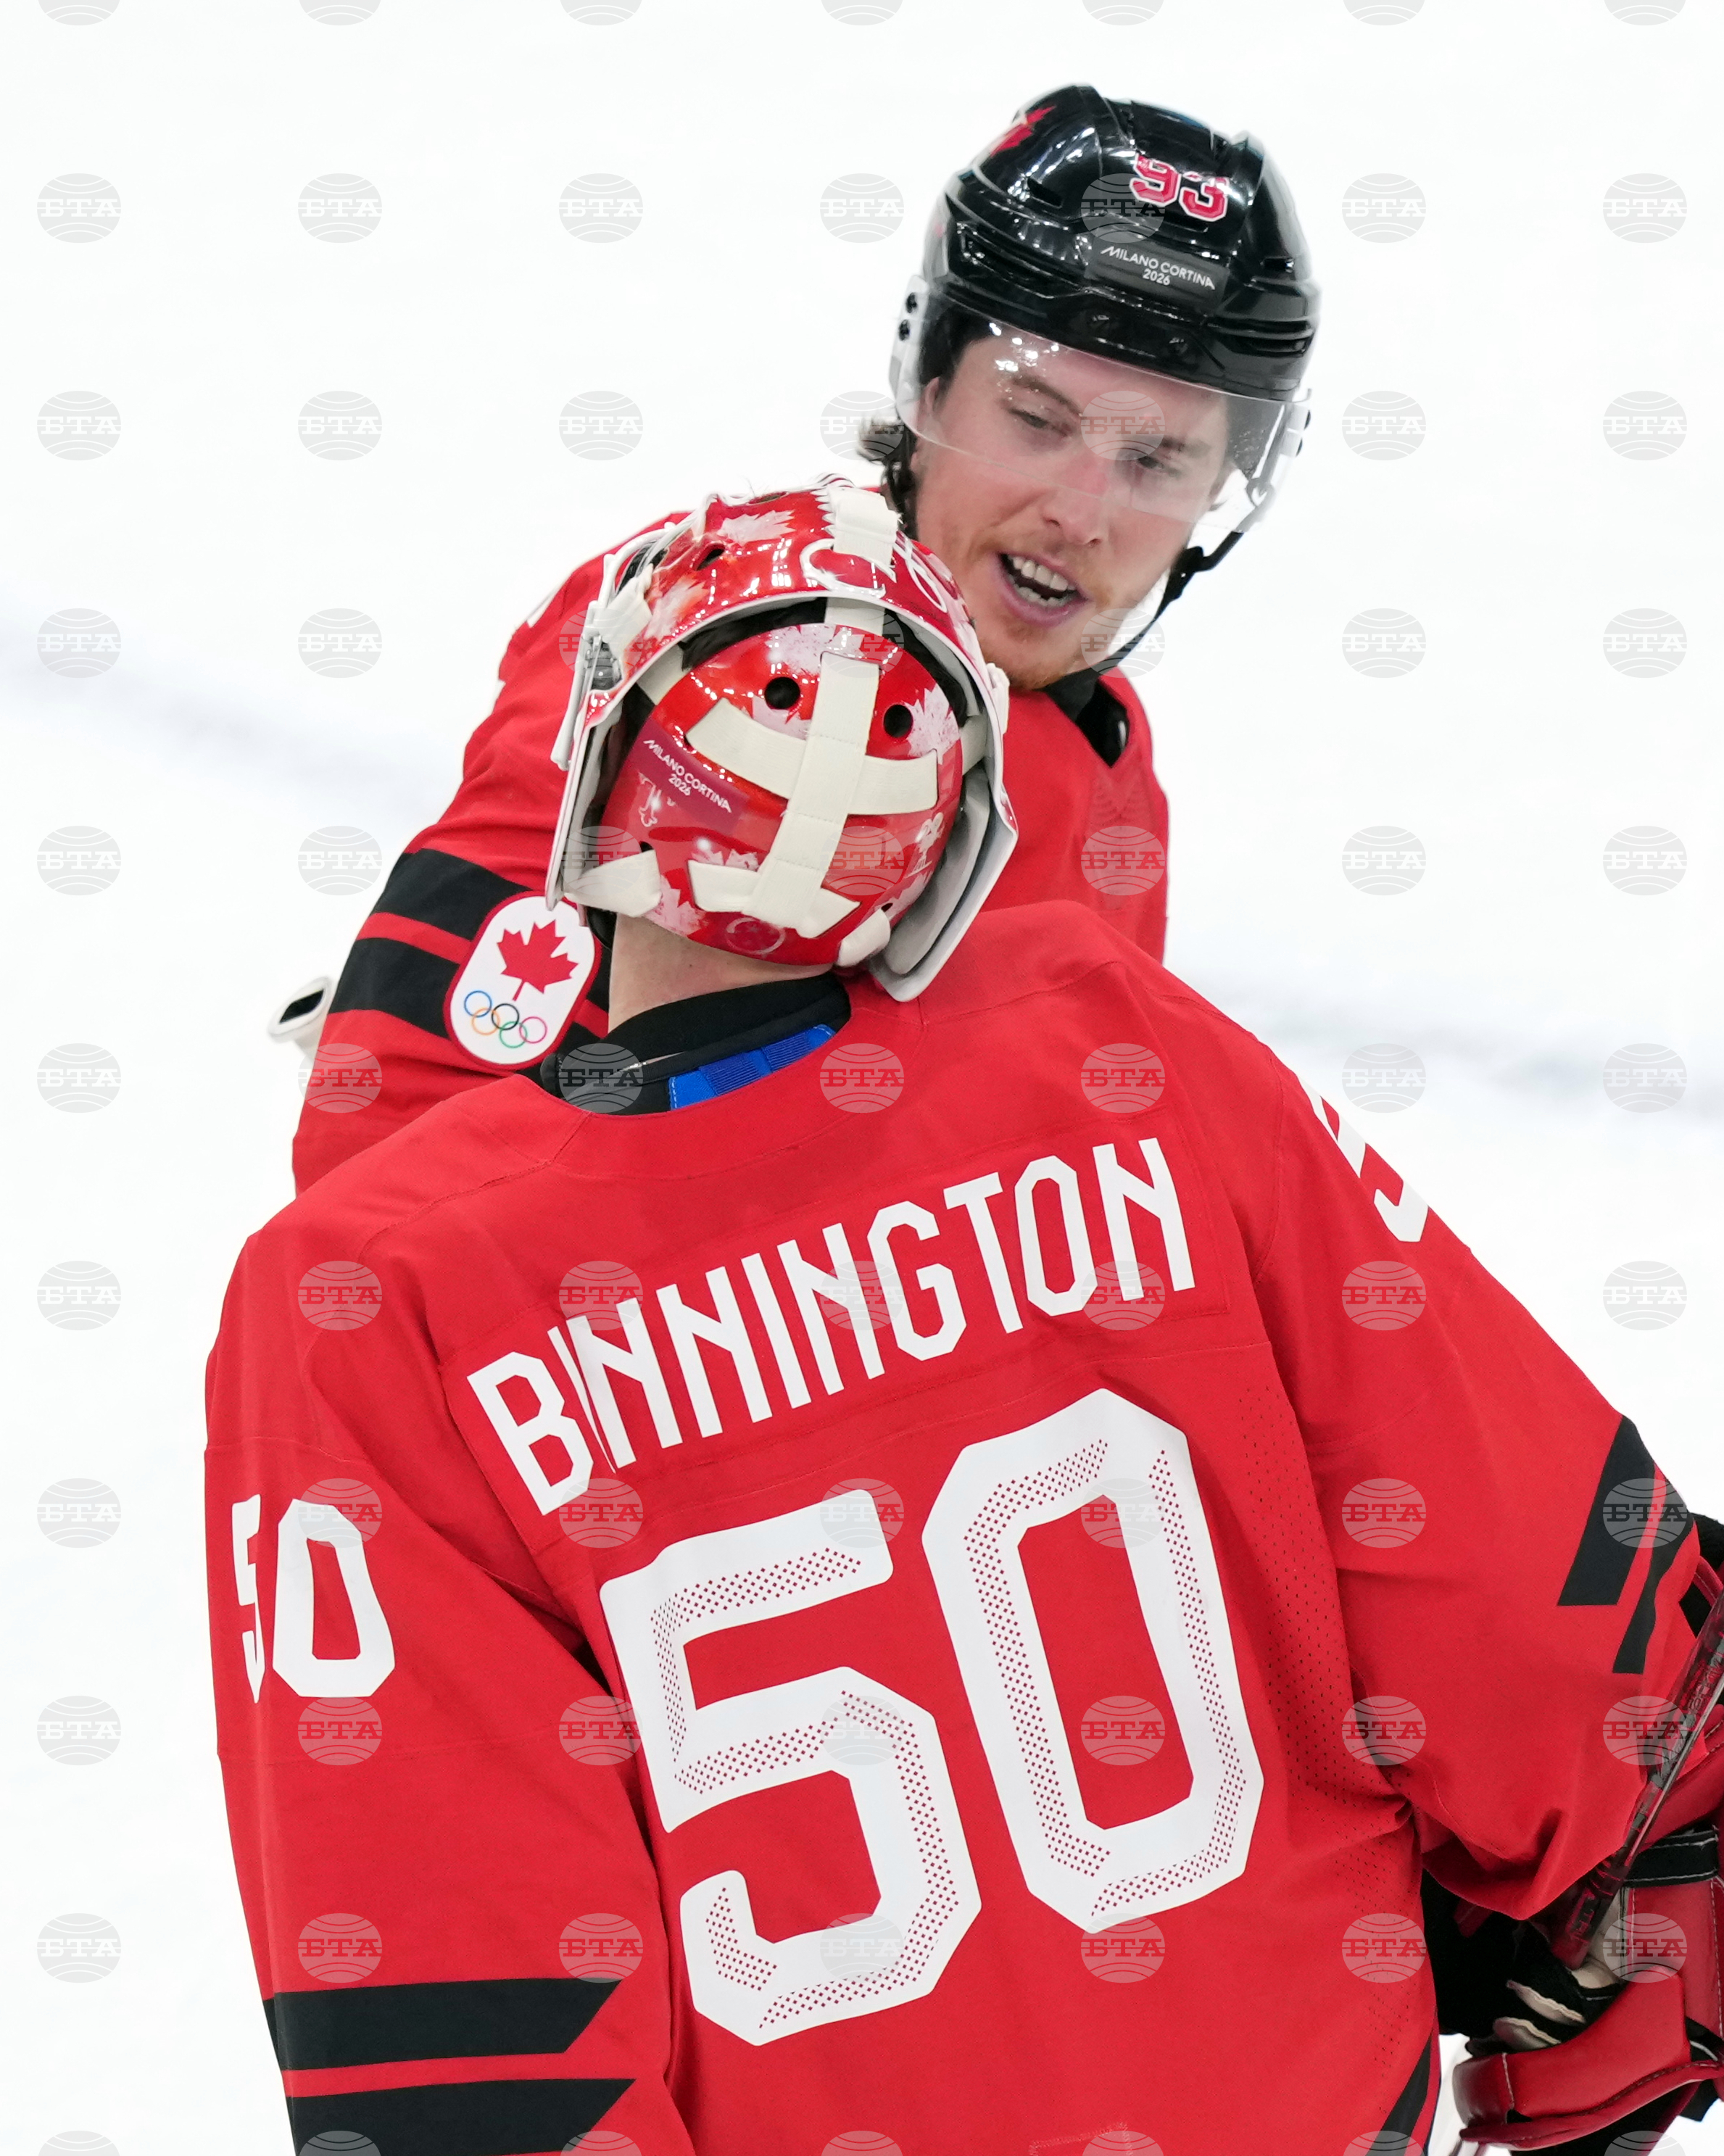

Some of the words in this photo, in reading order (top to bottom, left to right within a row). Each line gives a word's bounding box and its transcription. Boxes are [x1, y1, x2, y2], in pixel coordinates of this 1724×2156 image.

[1130, 153, 1229, 222] 93
[1101, 246, 1159, 269] MILANO
[1160, 262, 1216, 290] CORTINA
[1143, 268, 1170, 286] 2026
[643, 739, 685, 776] MILANO
[684, 773, 732, 813] CORTINA
[668, 773, 692, 796] 2026
[466, 1137, 1195, 1516] BINNINGTON
[231, 1493, 396, 1704] 50
[600, 1388, 1264, 2047] 50
